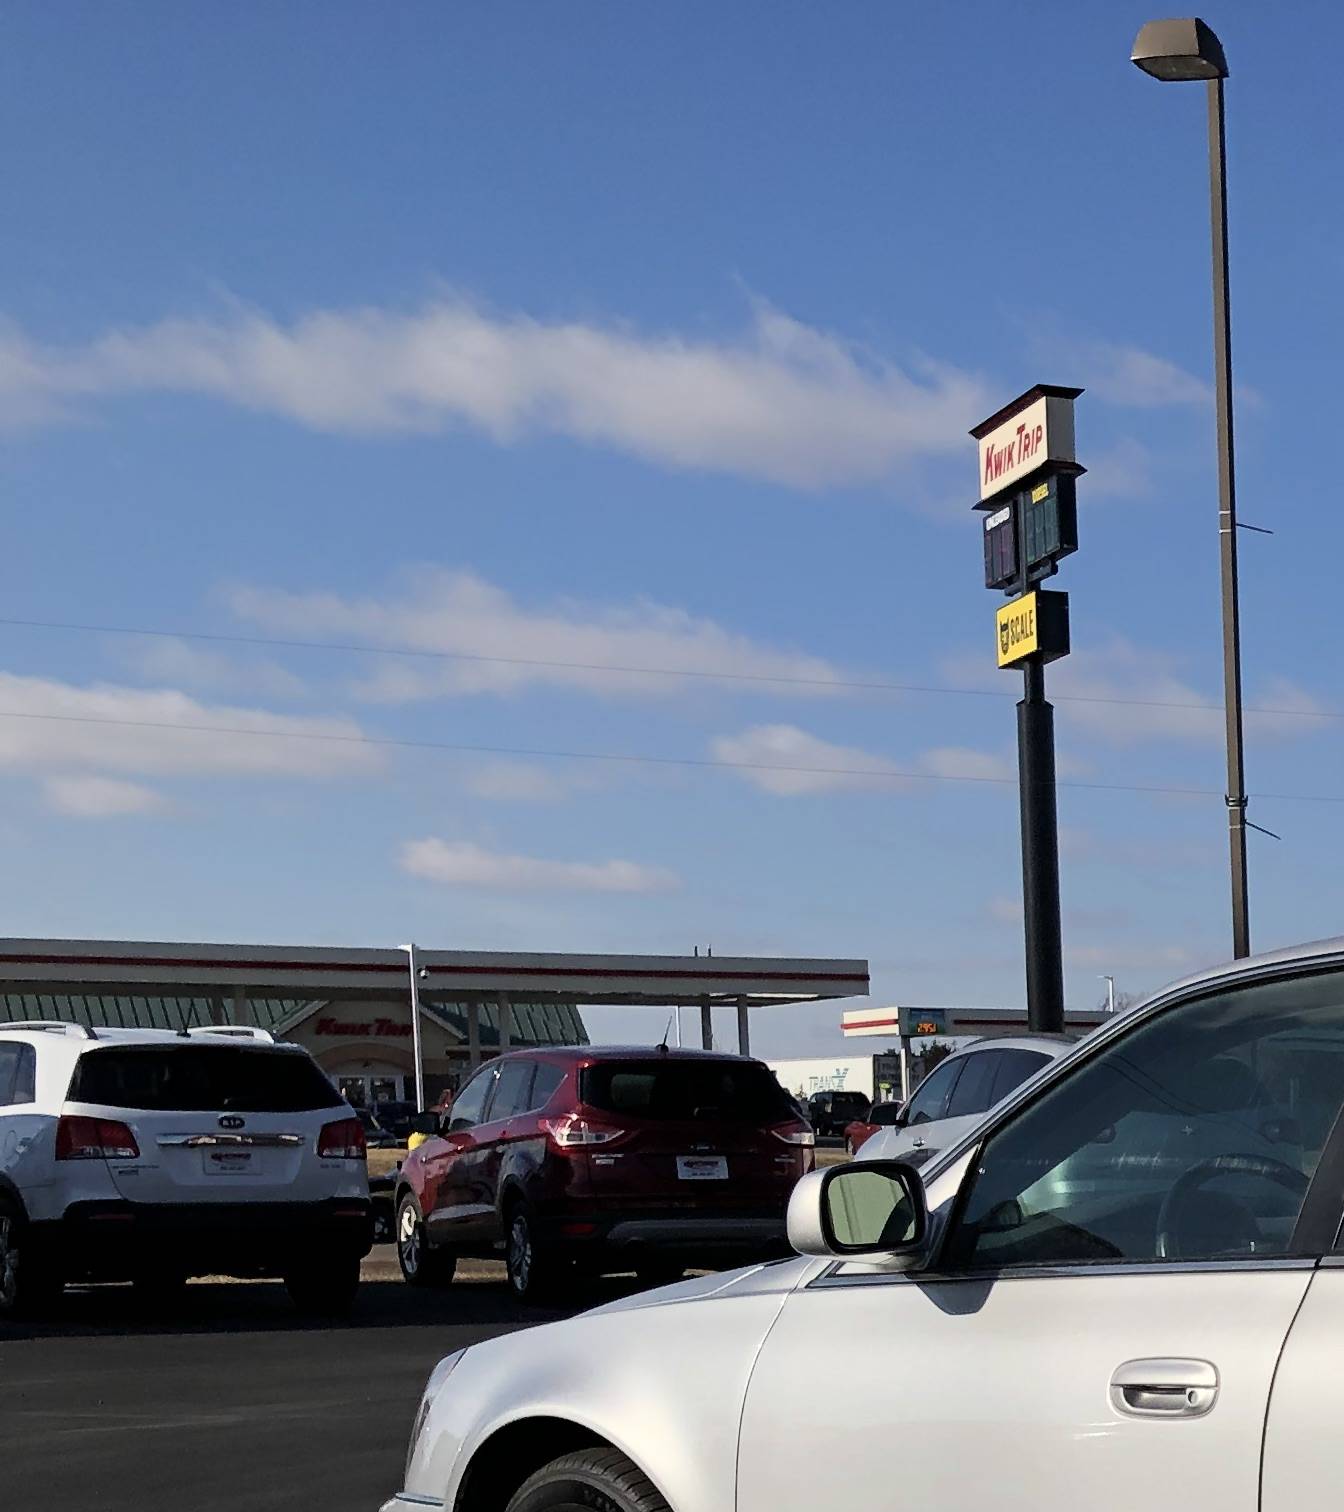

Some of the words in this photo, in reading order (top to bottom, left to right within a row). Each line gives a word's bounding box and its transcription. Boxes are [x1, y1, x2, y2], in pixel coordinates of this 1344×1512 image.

[984, 441, 1015, 486] KWIK
[1016, 422, 1043, 465] TRIP
[1010, 609, 1034, 646] SCALE
